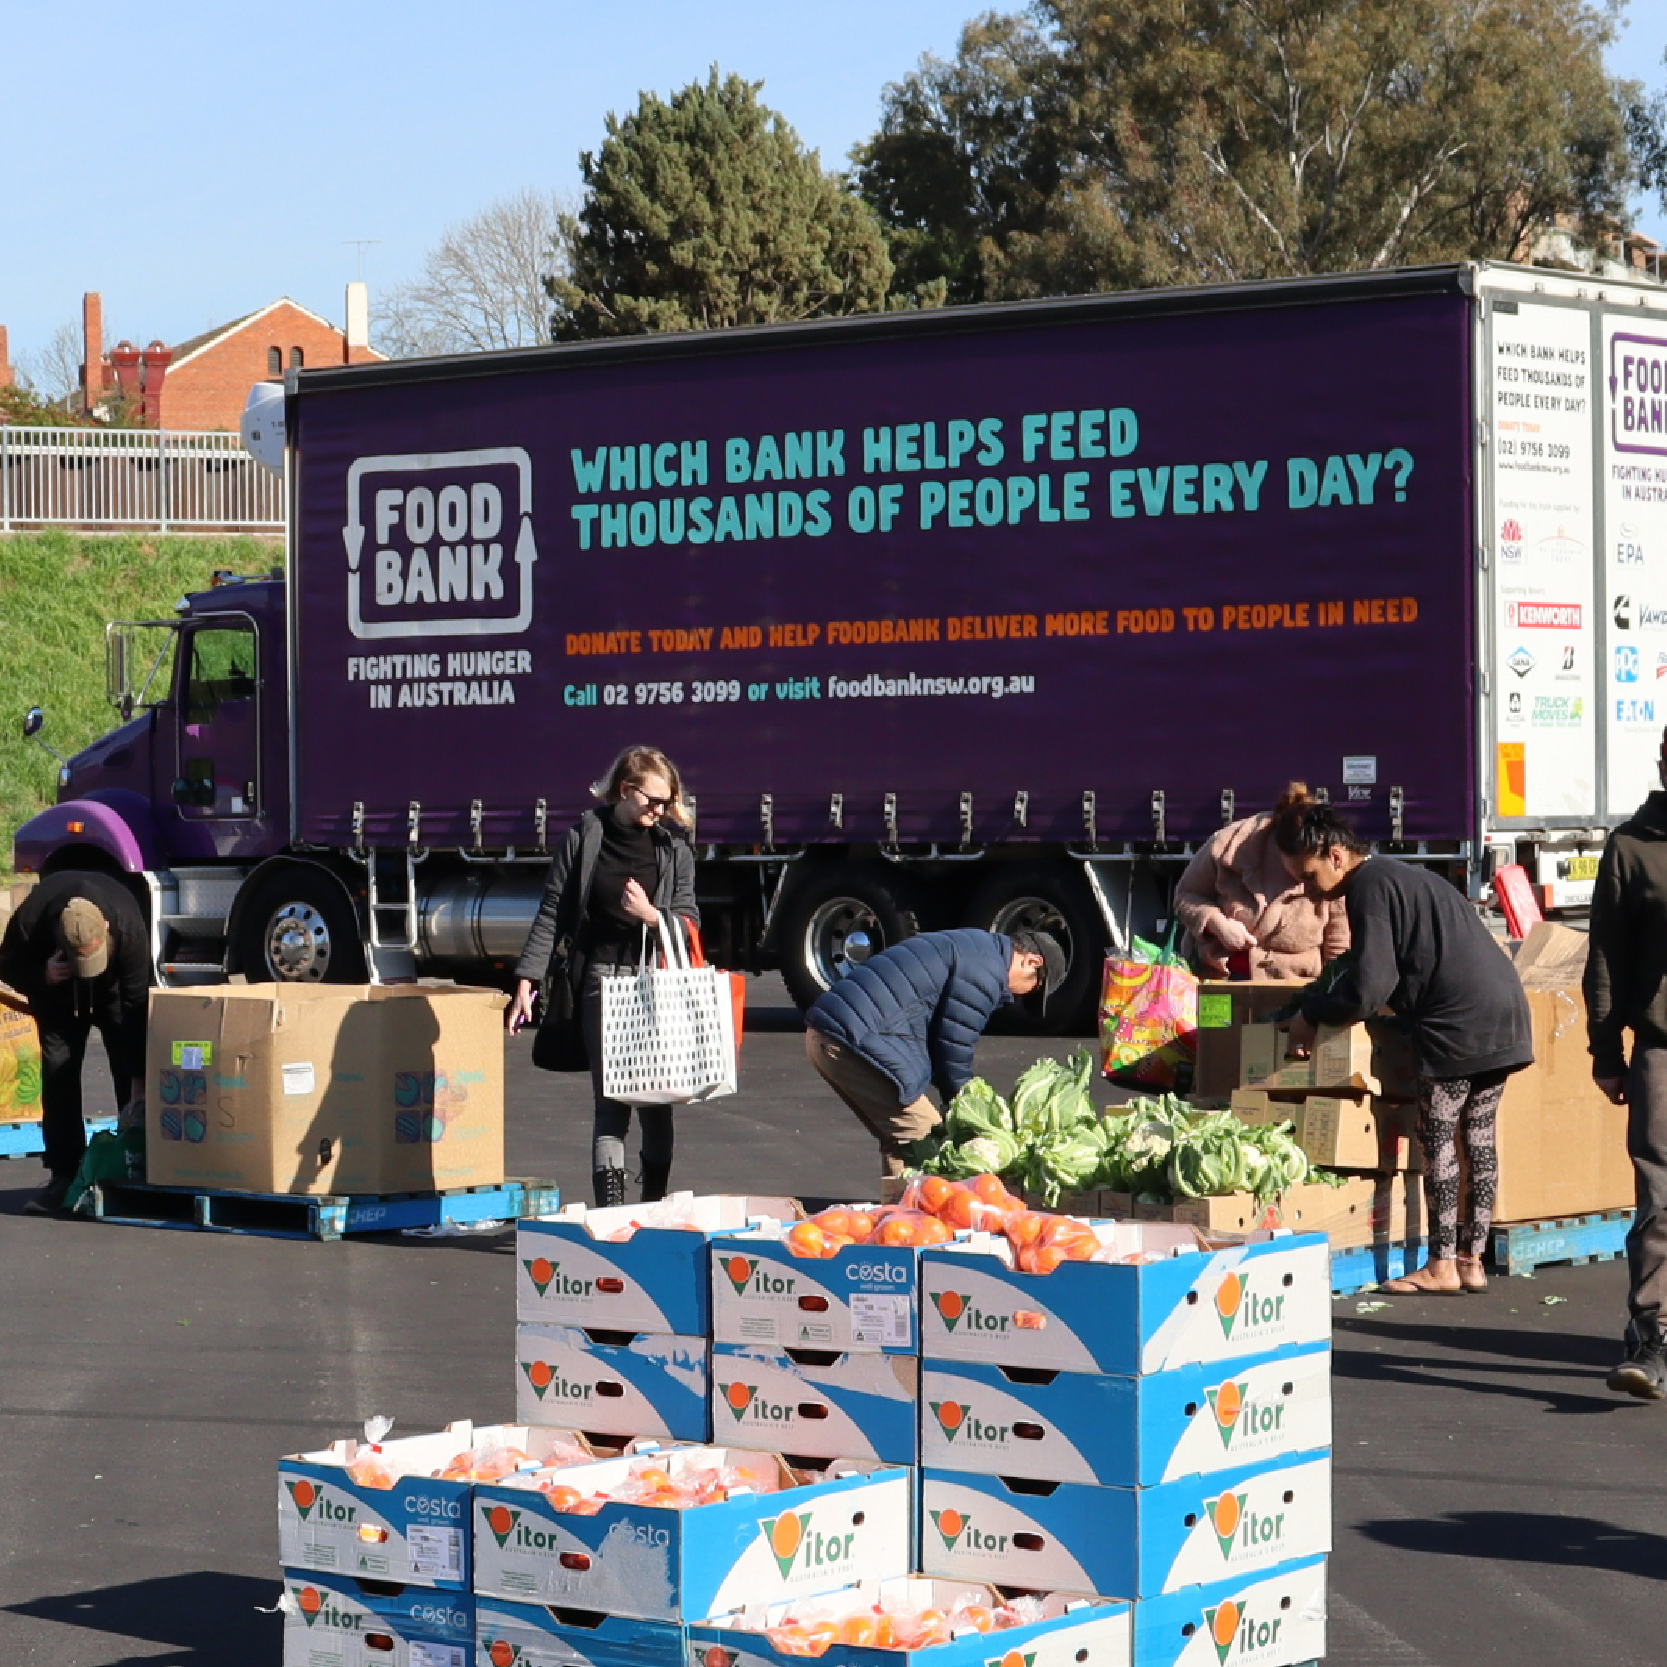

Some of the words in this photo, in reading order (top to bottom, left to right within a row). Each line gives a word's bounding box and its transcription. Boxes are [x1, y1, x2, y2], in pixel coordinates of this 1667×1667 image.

[1623, 355, 1667, 395] FOO
[1498, 390, 1531, 408] PEOPLE
[1623, 396, 1667, 434] BAN
[570, 440, 708, 494] WHICH
[725, 428, 846, 484] BANK
[863, 417, 1005, 473] HELPS
[1022, 407, 1138, 462] FEED
[375, 482, 502, 545] FOOD
[570, 489, 832, 550] THOUSANDS
[848, 482, 904, 534] OF
[920, 471, 1091, 530] PEOPLE
[1109, 460, 1269, 519] EVERY
[1286, 448, 1415, 509] DAY?
[1617, 543, 1644, 565] EPA
[375, 543, 504, 606] BANK
[566, 631, 641, 656] DONATE
[647, 628, 713, 653] TODAY
[719, 625, 763, 650] AND
[769, 623, 821, 648] HELP
[827, 618, 940, 645] FOODBANK
[947, 614, 1038, 641] DELIVER
[1045, 610, 1110, 637] MORE
[1116, 607, 1175, 634] FOOD
[1181, 606, 1215, 631] TO
[1222, 603, 1310, 630] PEOPLE
[1317, 601, 1344, 627] IN
[1353, 596, 1418, 625] NEED
[1519, 605, 1580, 626] KENWORTH
[347, 653, 441, 681] FIGHTING
[447, 650, 532, 678] HUNGER
[369, 684, 393, 709] IN
[397, 679, 516, 709] AUSTRALIA
[563, 679, 598, 707] Call
[603, 684, 629, 706] 02
[634, 681, 685, 705] 9756
[691, 679, 741, 703] 3099
[747, 682, 770, 702] or
[775, 676, 821, 700] visit
[828, 671, 1035, 699] foodbanknsw.org.au
[609, 1520, 671, 1547] sta
